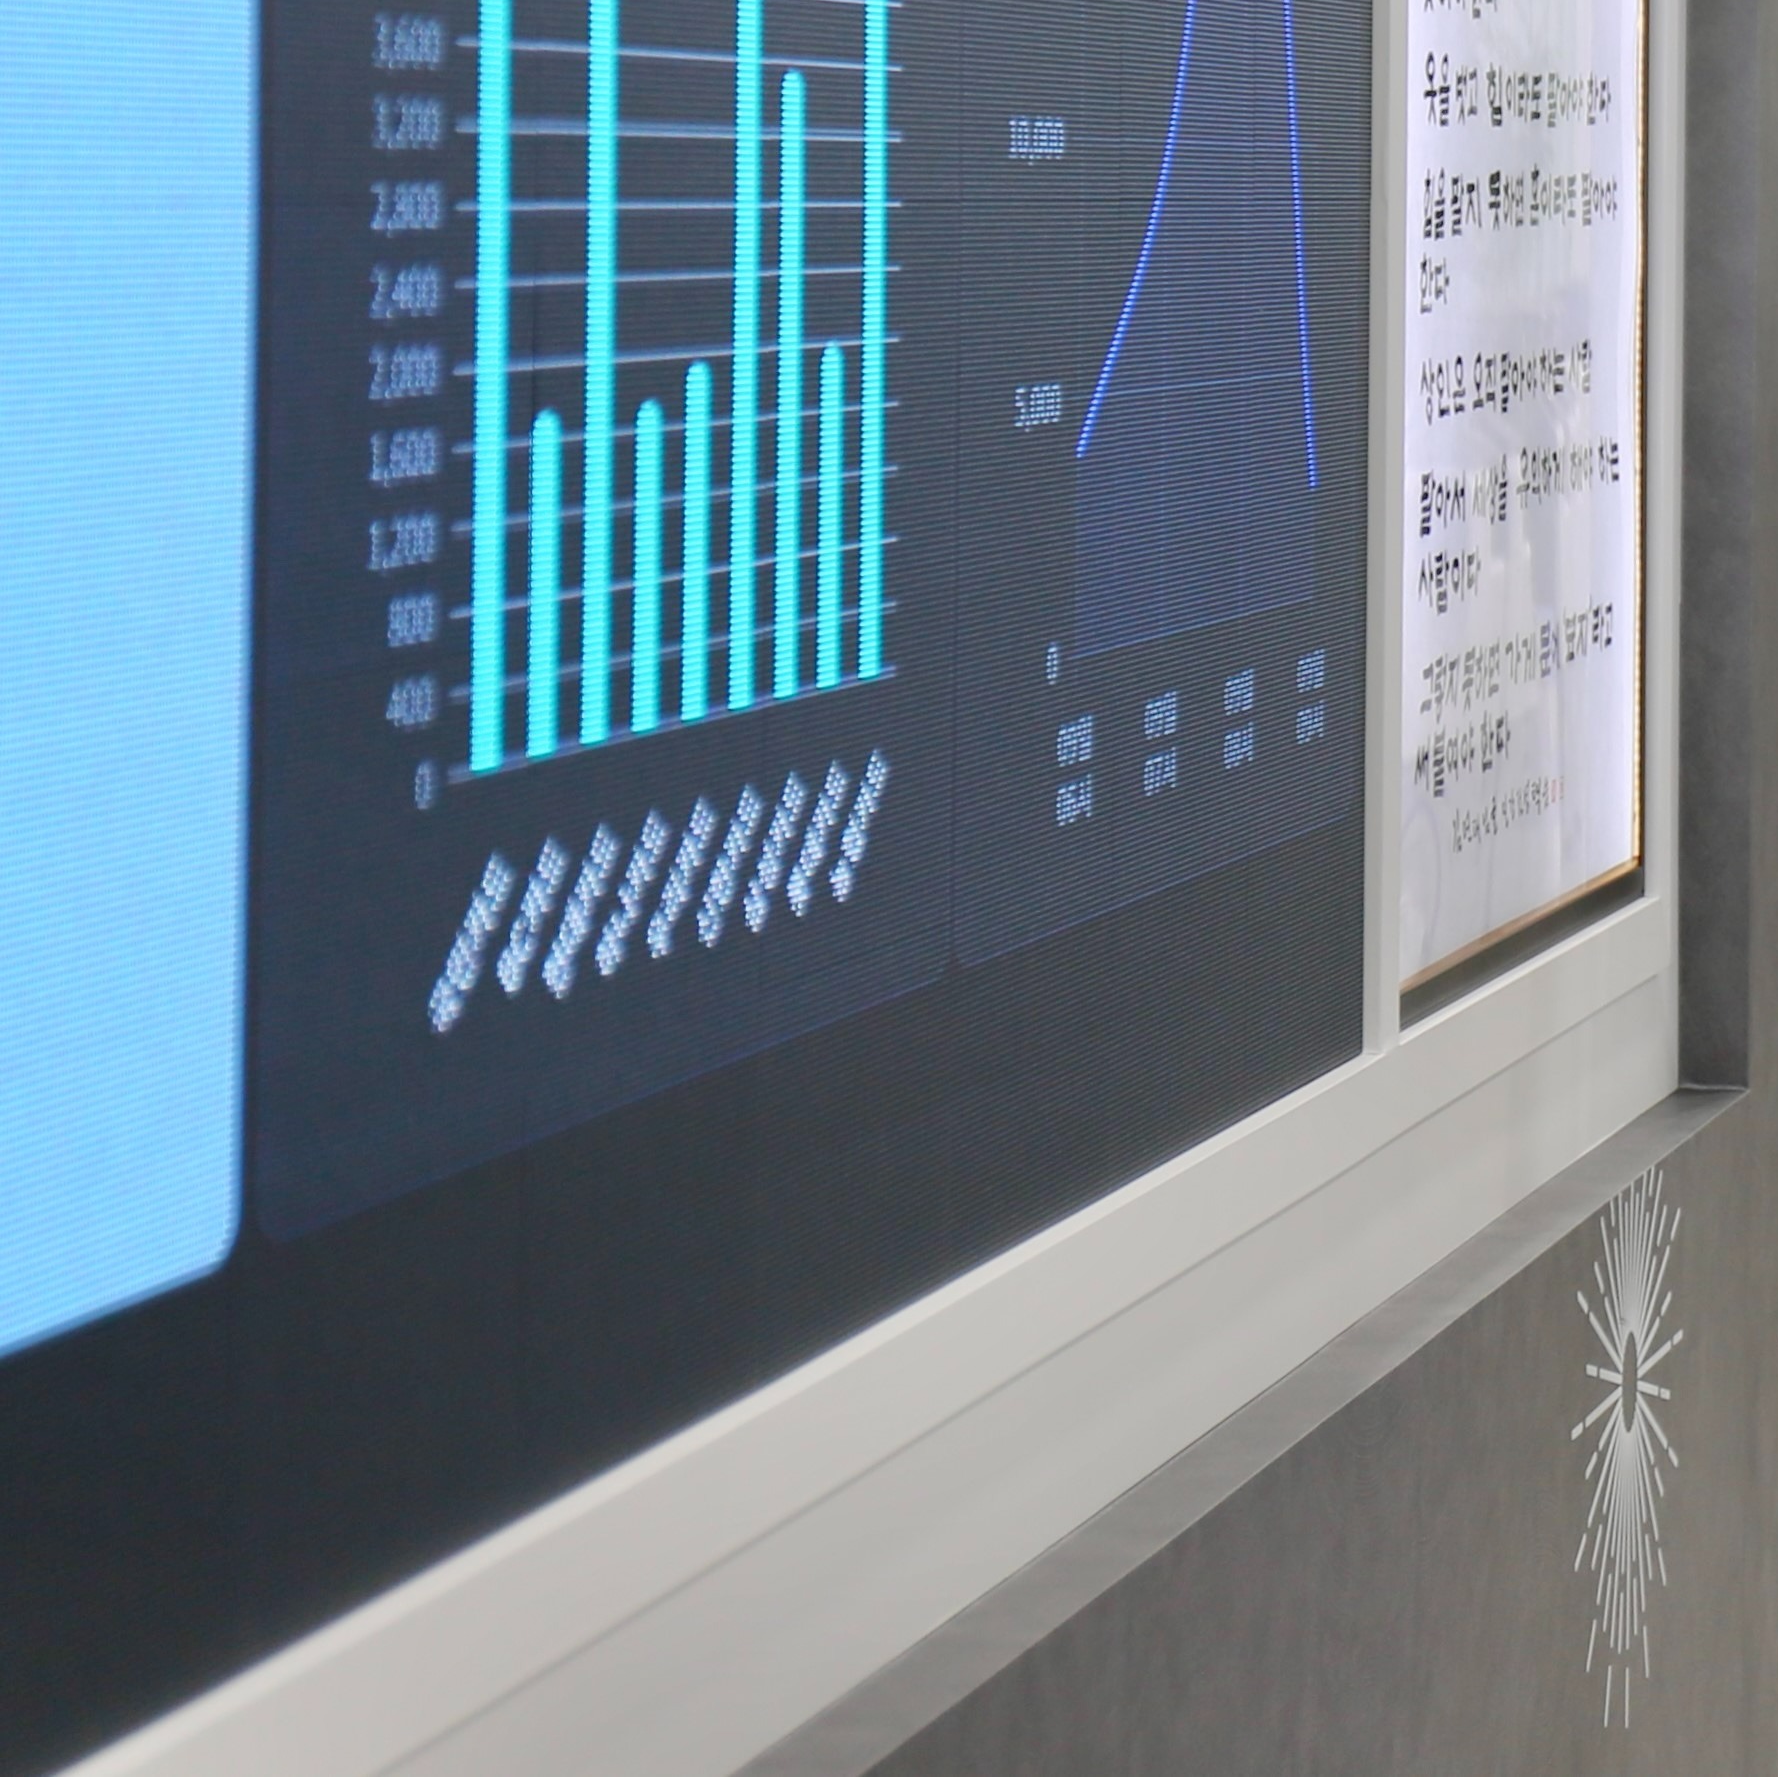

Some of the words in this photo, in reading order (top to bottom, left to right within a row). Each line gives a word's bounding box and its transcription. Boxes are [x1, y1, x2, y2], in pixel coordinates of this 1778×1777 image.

[1424, 53, 1450, 126] 옷을
[1456, 69, 1477, 120] 벗고
[1547, 73, 1583, 128] 팔아야
[1587, 74, 1611, 125] 한다
[1421, 355, 1466, 424] 상인은
[1473, 353, 1496, 409] 오직
[1569, 339, 1592, 393] 사람
[1419, 552, 1480, 613] 사람이다
